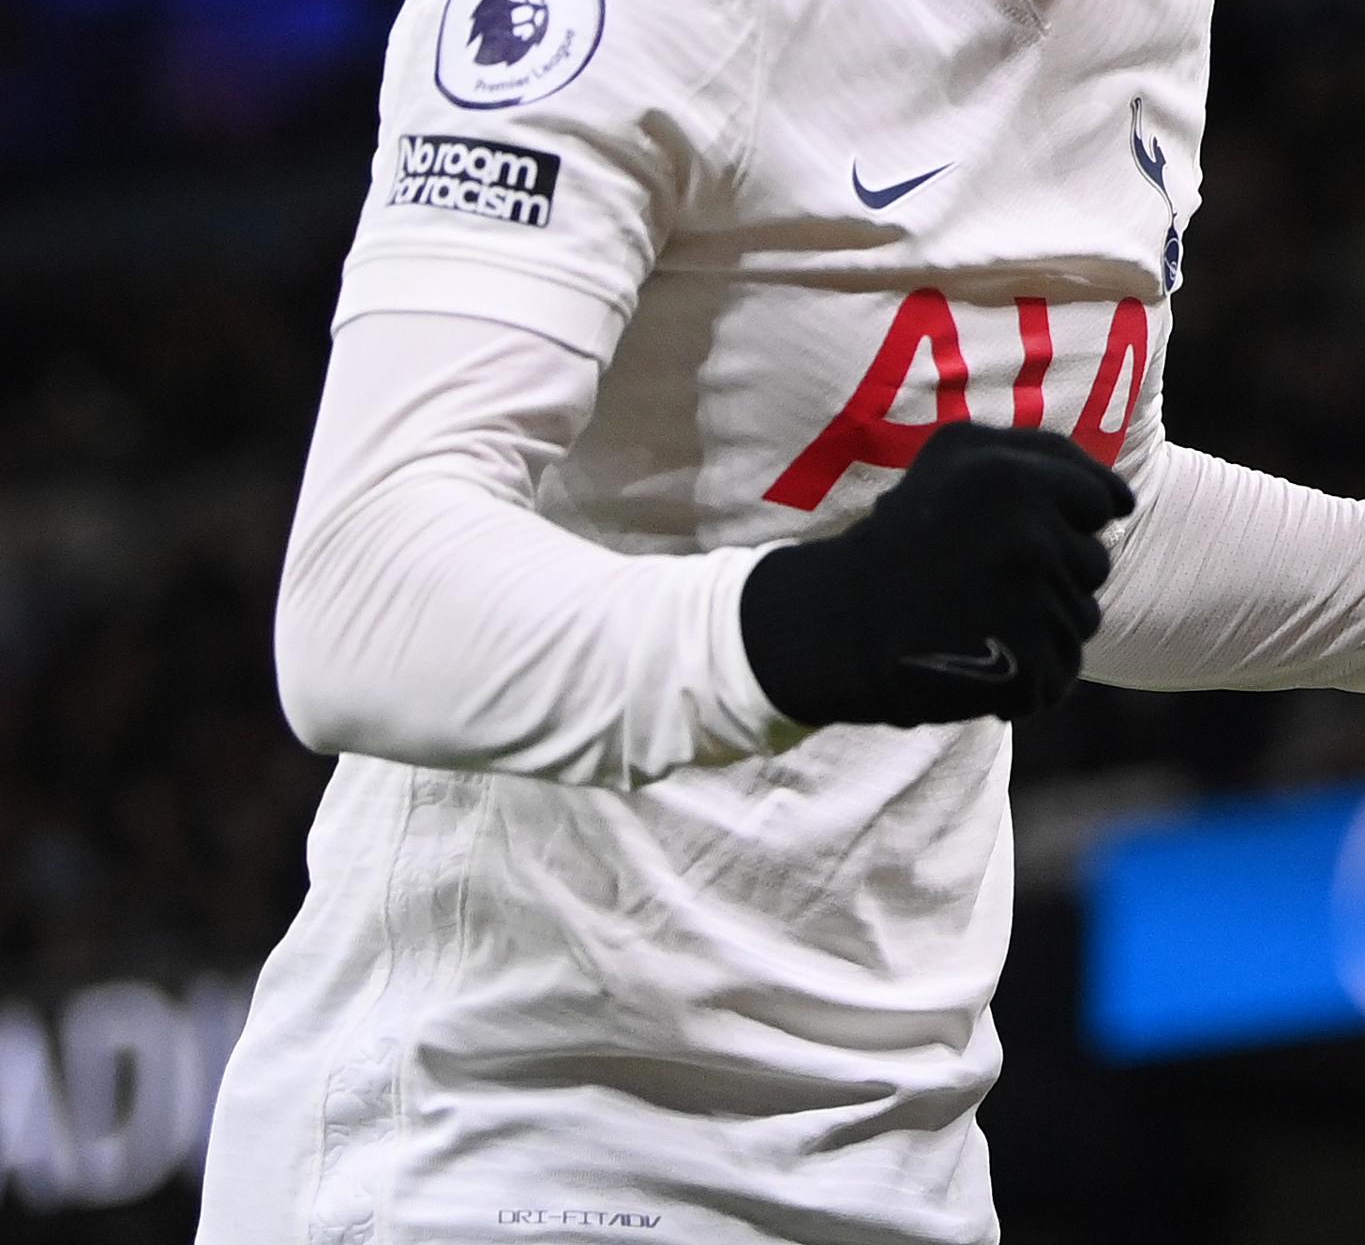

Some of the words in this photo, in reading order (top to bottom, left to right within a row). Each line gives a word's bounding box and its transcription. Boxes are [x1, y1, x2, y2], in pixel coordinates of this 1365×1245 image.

[400, 135, 434, 175] No
[432, 142, 538, 190] room
[419, 175, 550, 227] racism
[762, 287, 1148, 512] AIA
